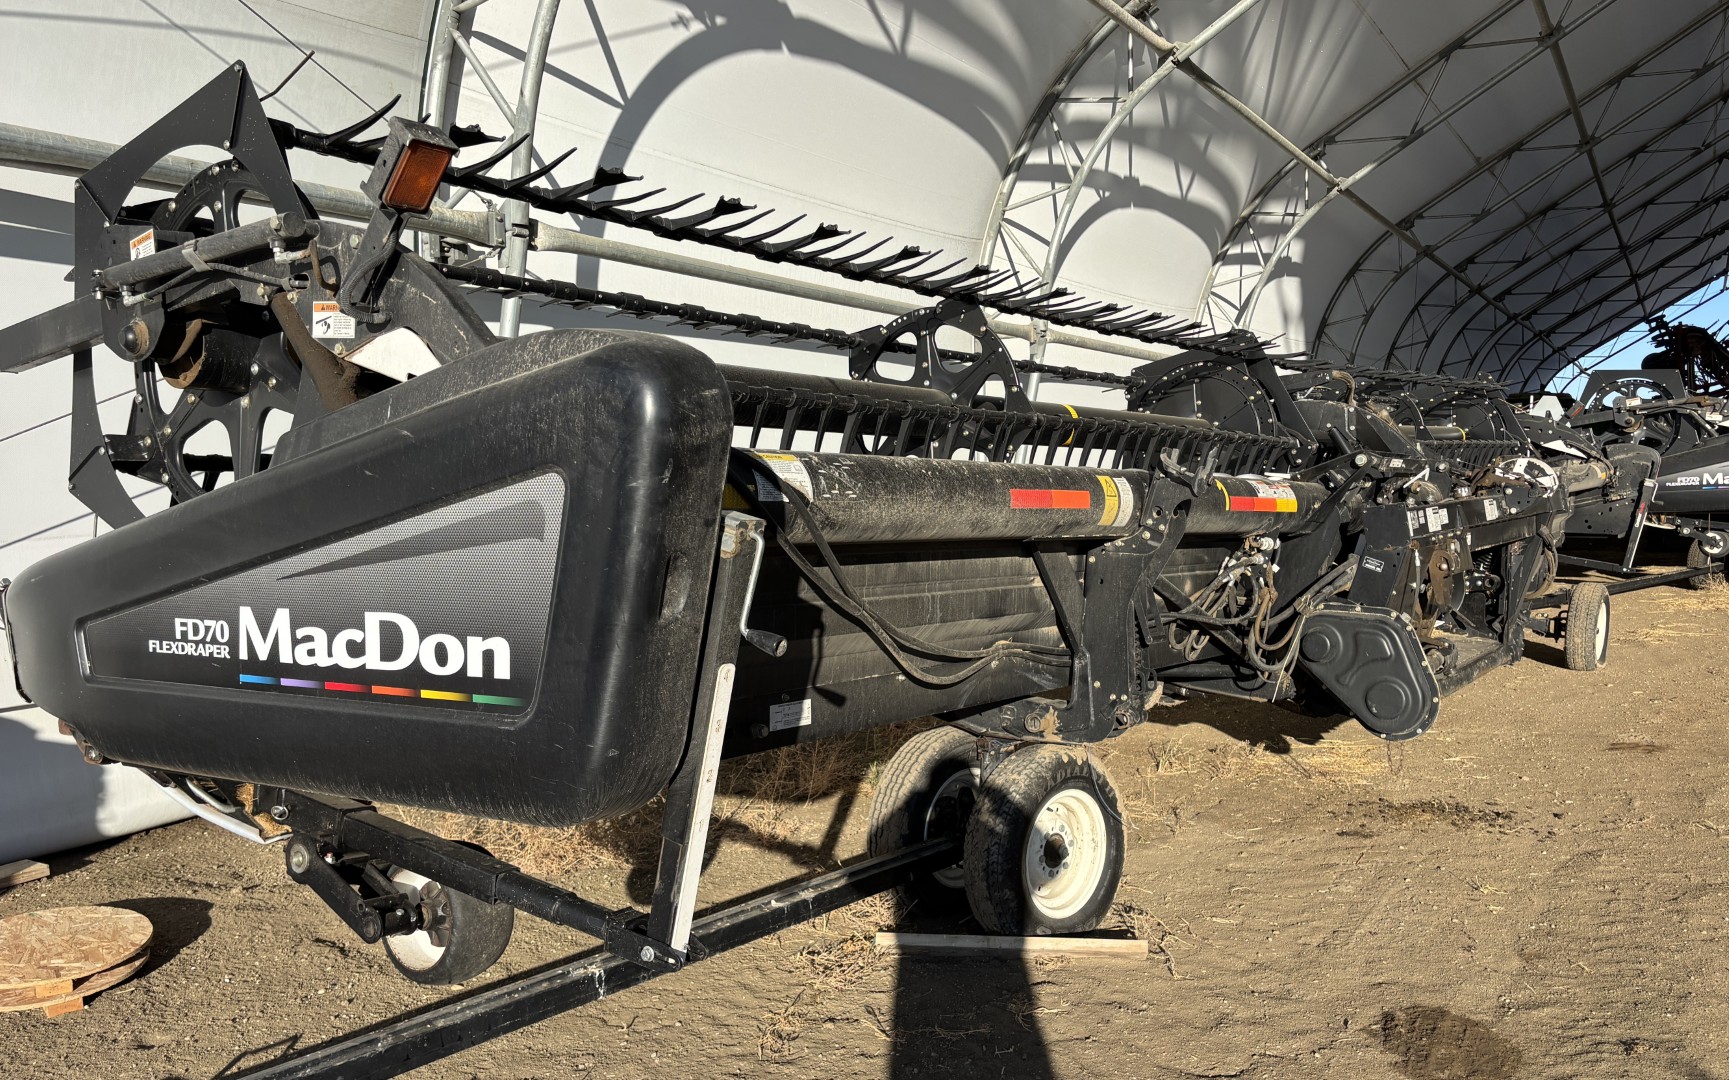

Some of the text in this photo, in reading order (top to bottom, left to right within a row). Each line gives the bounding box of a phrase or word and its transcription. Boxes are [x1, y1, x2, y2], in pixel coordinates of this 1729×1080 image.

[174, 618, 229, 640] FD70
[149, 642, 230, 659] FLEXDRAPER
[239, 606, 511, 680] MacDon
